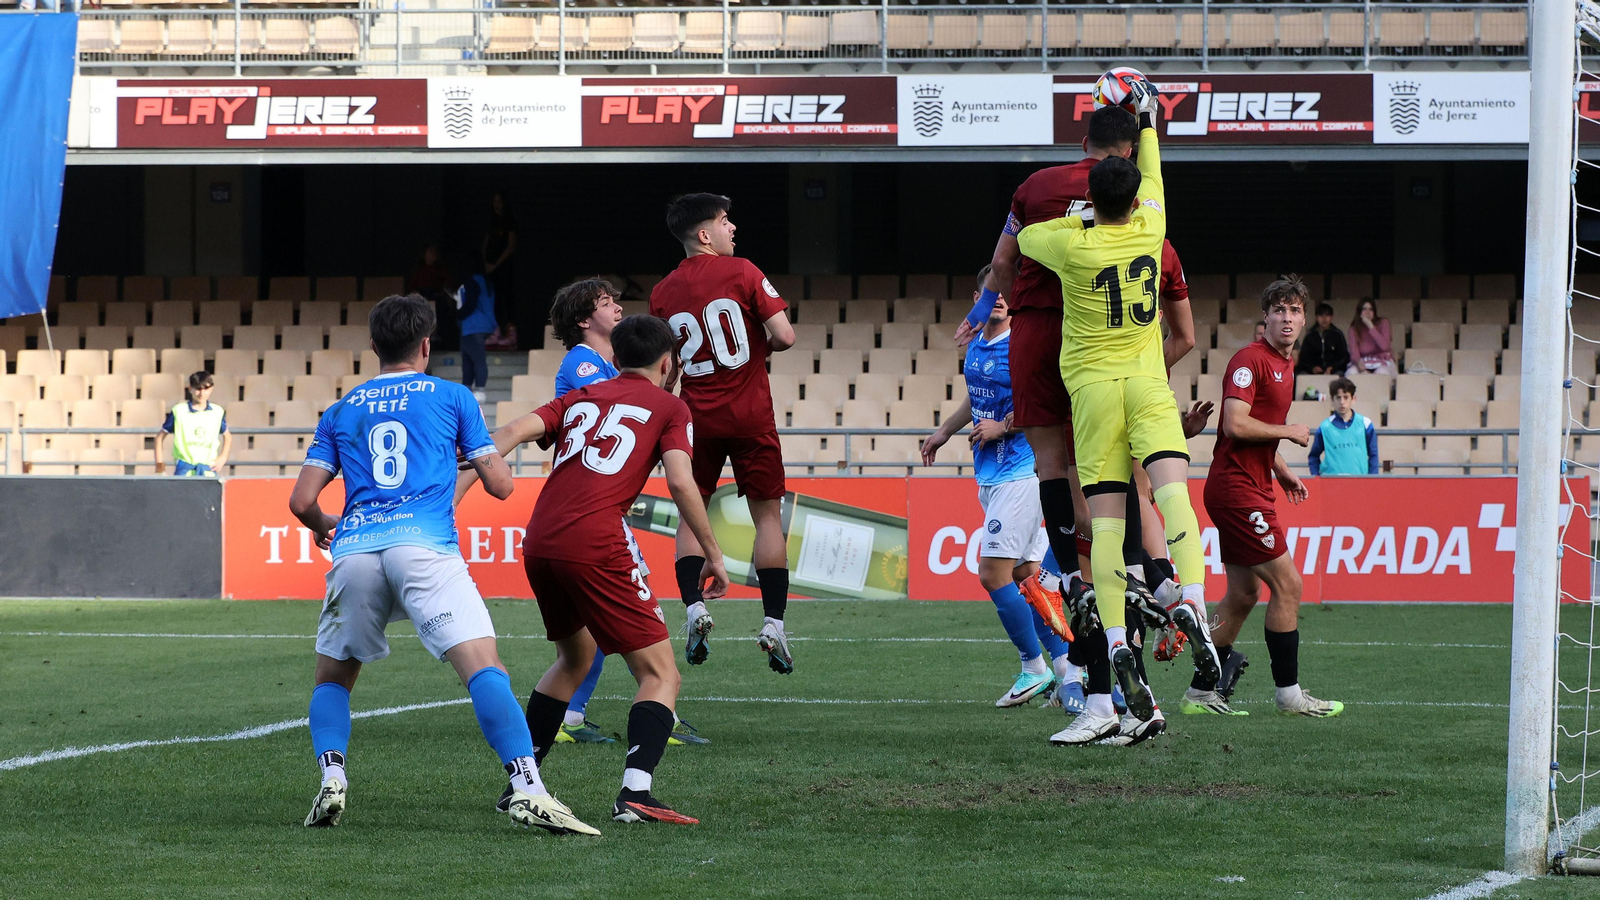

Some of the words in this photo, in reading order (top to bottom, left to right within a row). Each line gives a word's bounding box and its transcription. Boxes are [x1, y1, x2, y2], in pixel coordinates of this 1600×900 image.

[481, 103, 566, 115] Ayuntamiento
[951, 101, 1038, 113] Ayuntamiento
[1428, 98, 1516, 110] Ayuntamiento
[481, 116, 495, 125] de
[499, 116, 529, 126] Jerez
[951, 113, 966, 123] de
[969, 113, 1000, 125] Jerez
[1428, 111, 1443, 120] de
[1446, 111, 1478, 122] Jerez
[1092, 255, 1158, 328] 13
[667, 298, 750, 377] 20
[366, 394, 409, 414] TETÉ
[554, 402, 652, 475] 35
[368, 421, 408, 489] 8
[1248, 511, 1270, 535] 3
[335, 534, 360, 549] XEREZ
[362, 525, 421, 542] DEPORTIVO
